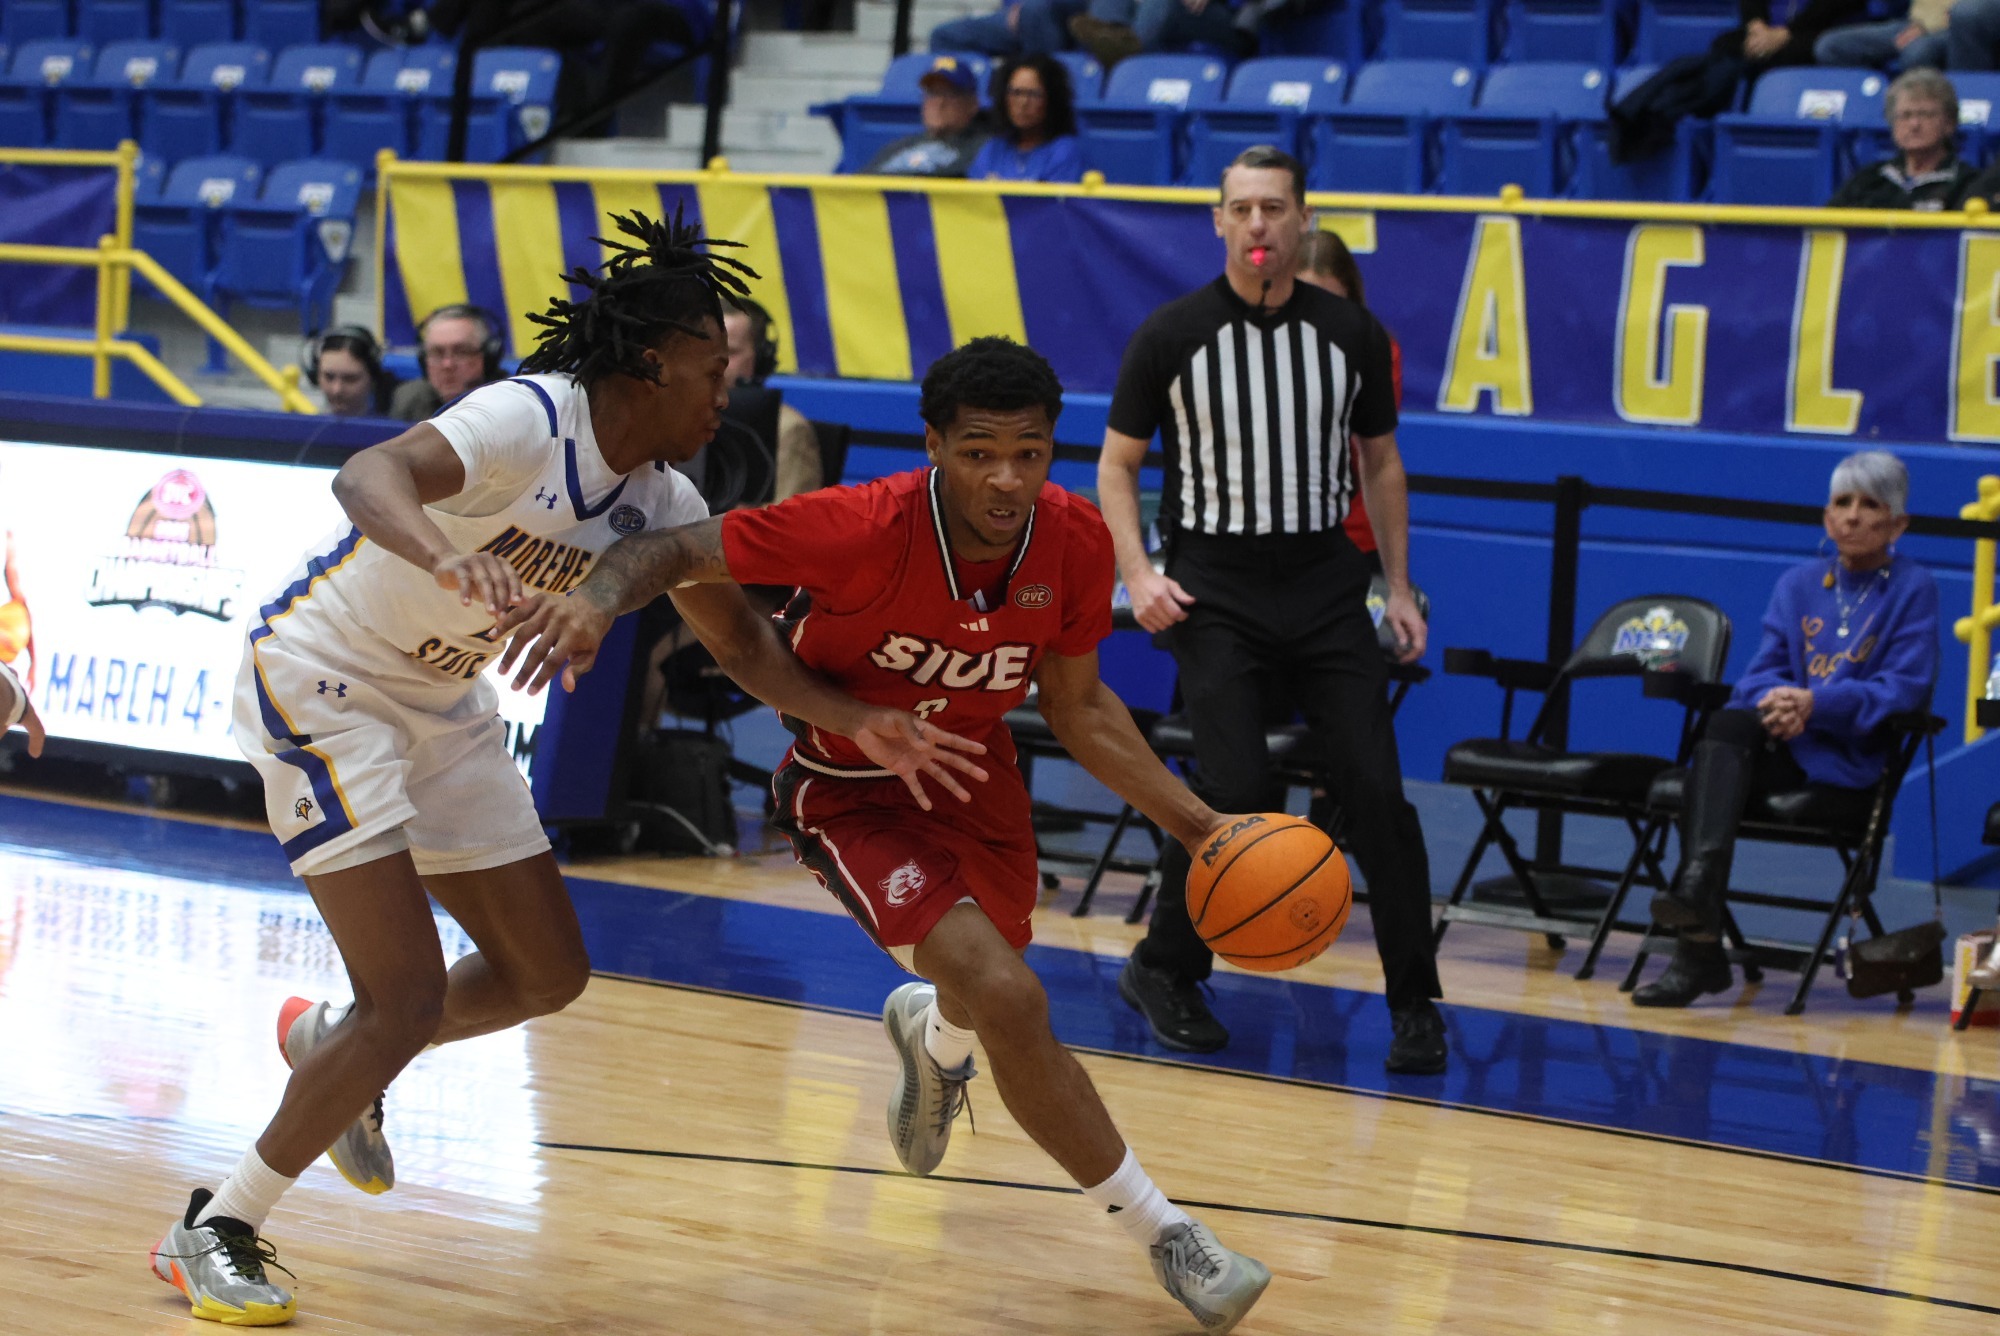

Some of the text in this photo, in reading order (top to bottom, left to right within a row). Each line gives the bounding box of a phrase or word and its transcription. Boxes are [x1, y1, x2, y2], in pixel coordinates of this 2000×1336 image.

[1312, 212, 2000, 443] AGLE
[1021, 590, 1046, 602] OVC
[43, 651, 175, 726] MARCH
[867, 631, 1035, 692] SIUE
[1200, 815, 1267, 868] NCAA
